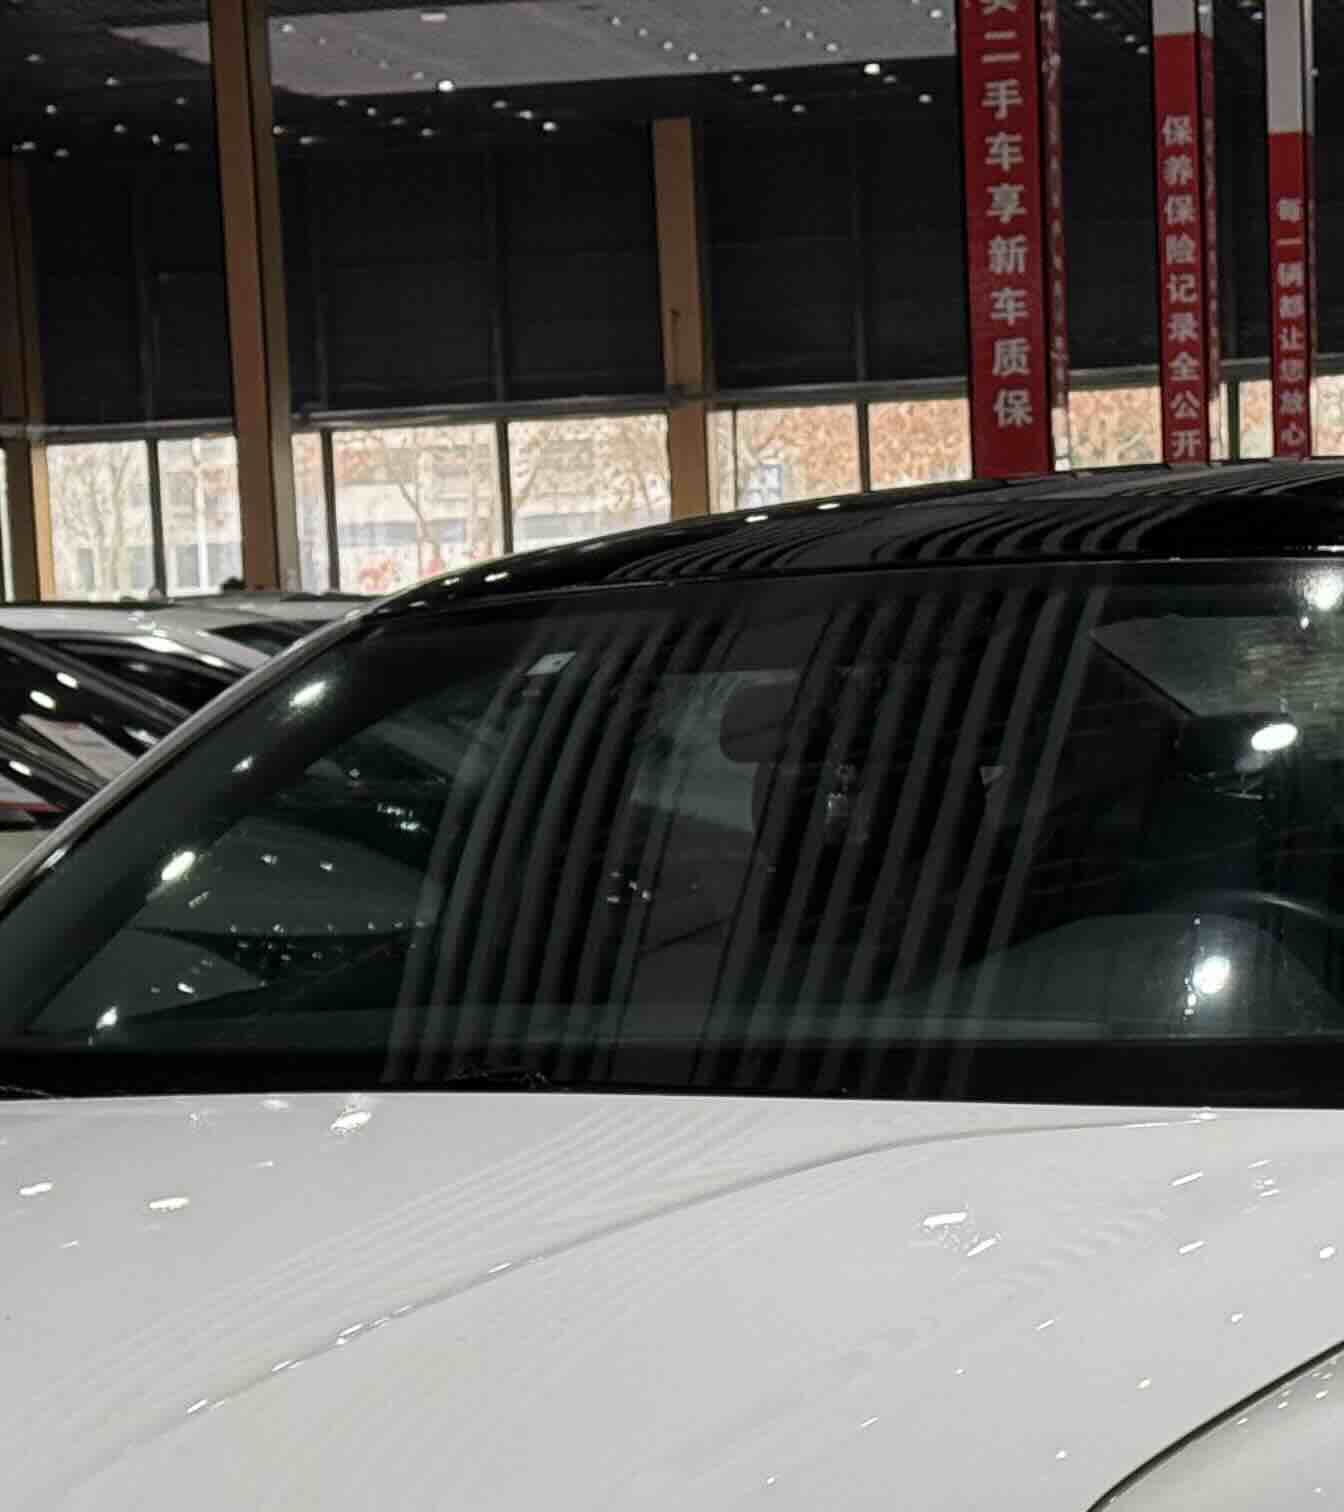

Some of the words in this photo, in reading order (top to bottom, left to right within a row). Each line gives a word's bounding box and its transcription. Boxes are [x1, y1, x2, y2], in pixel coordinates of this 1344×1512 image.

[1161, 115, 1203, 458] 保养保险记录全公开
